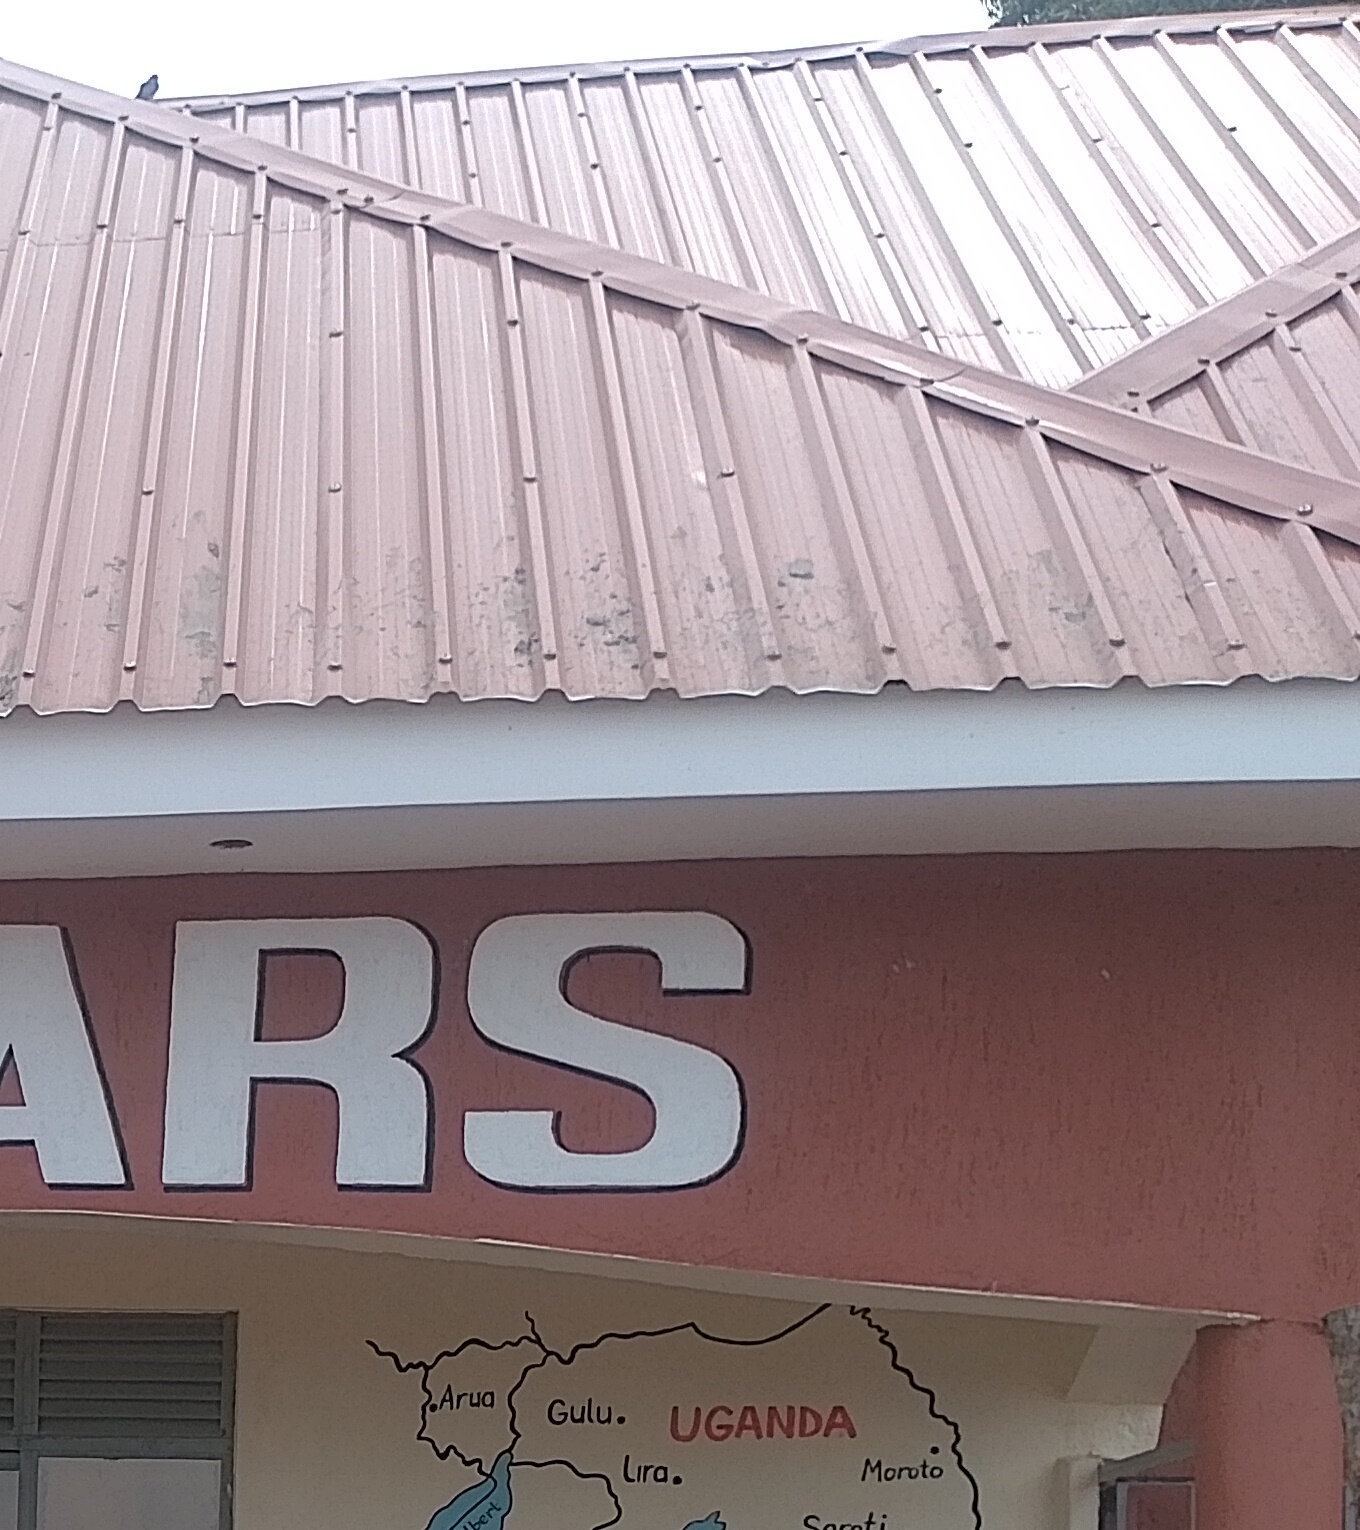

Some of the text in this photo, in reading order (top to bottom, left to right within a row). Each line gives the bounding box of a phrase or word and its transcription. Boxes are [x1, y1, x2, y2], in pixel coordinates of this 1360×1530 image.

[439, 1384, 496, 1410] Arua
[547, 1398, 613, 1426] Gulu
[669, 1404, 858, 1442] UGANDA
[861, 1458, 944, 1483] Moroto
